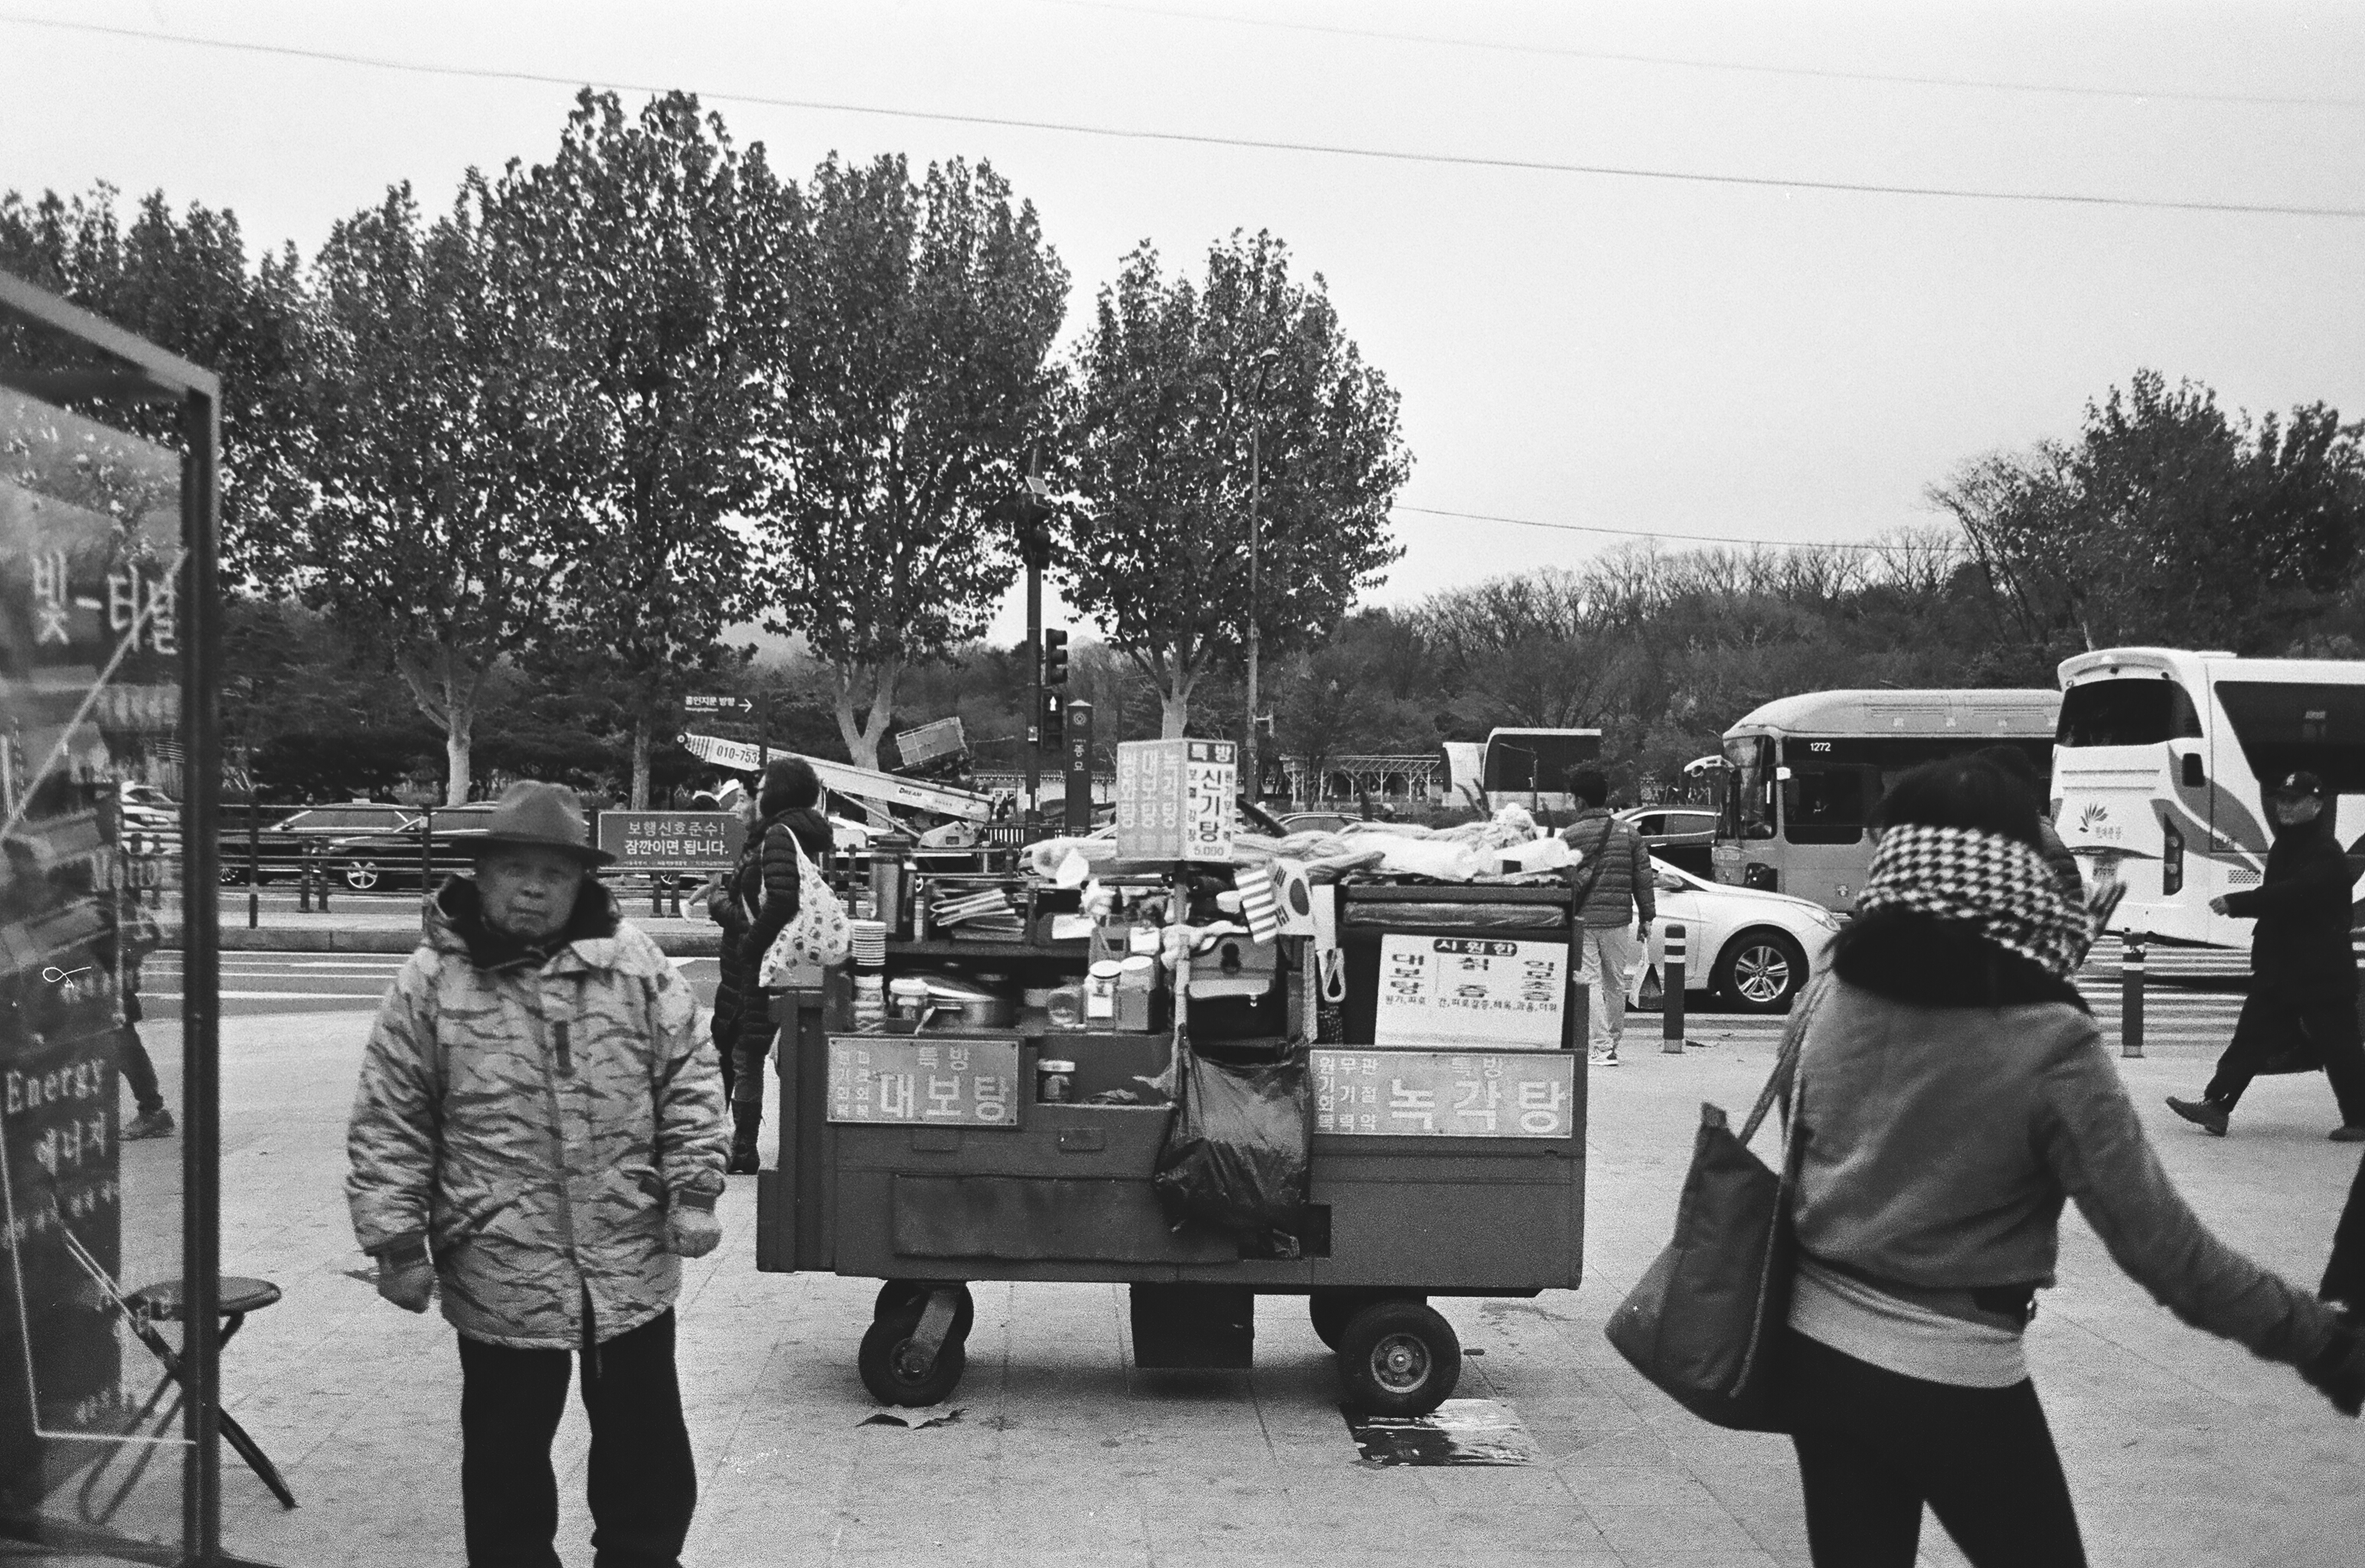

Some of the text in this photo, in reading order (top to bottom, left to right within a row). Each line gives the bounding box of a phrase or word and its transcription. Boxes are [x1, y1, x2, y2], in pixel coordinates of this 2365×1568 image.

[719, 697, 735, 707] 방향
[1810, 742, 1831, 752] 1272
[1200, 769, 1221, 842] 신기탕
[625, 839, 729, 856] 잠깐이면 됩니다.
[1436, 940, 1514, 956] 시원한
[880, 1073, 1010, 1122] 대보탕
[1389, 1078, 1567, 1134] 녹각탕
